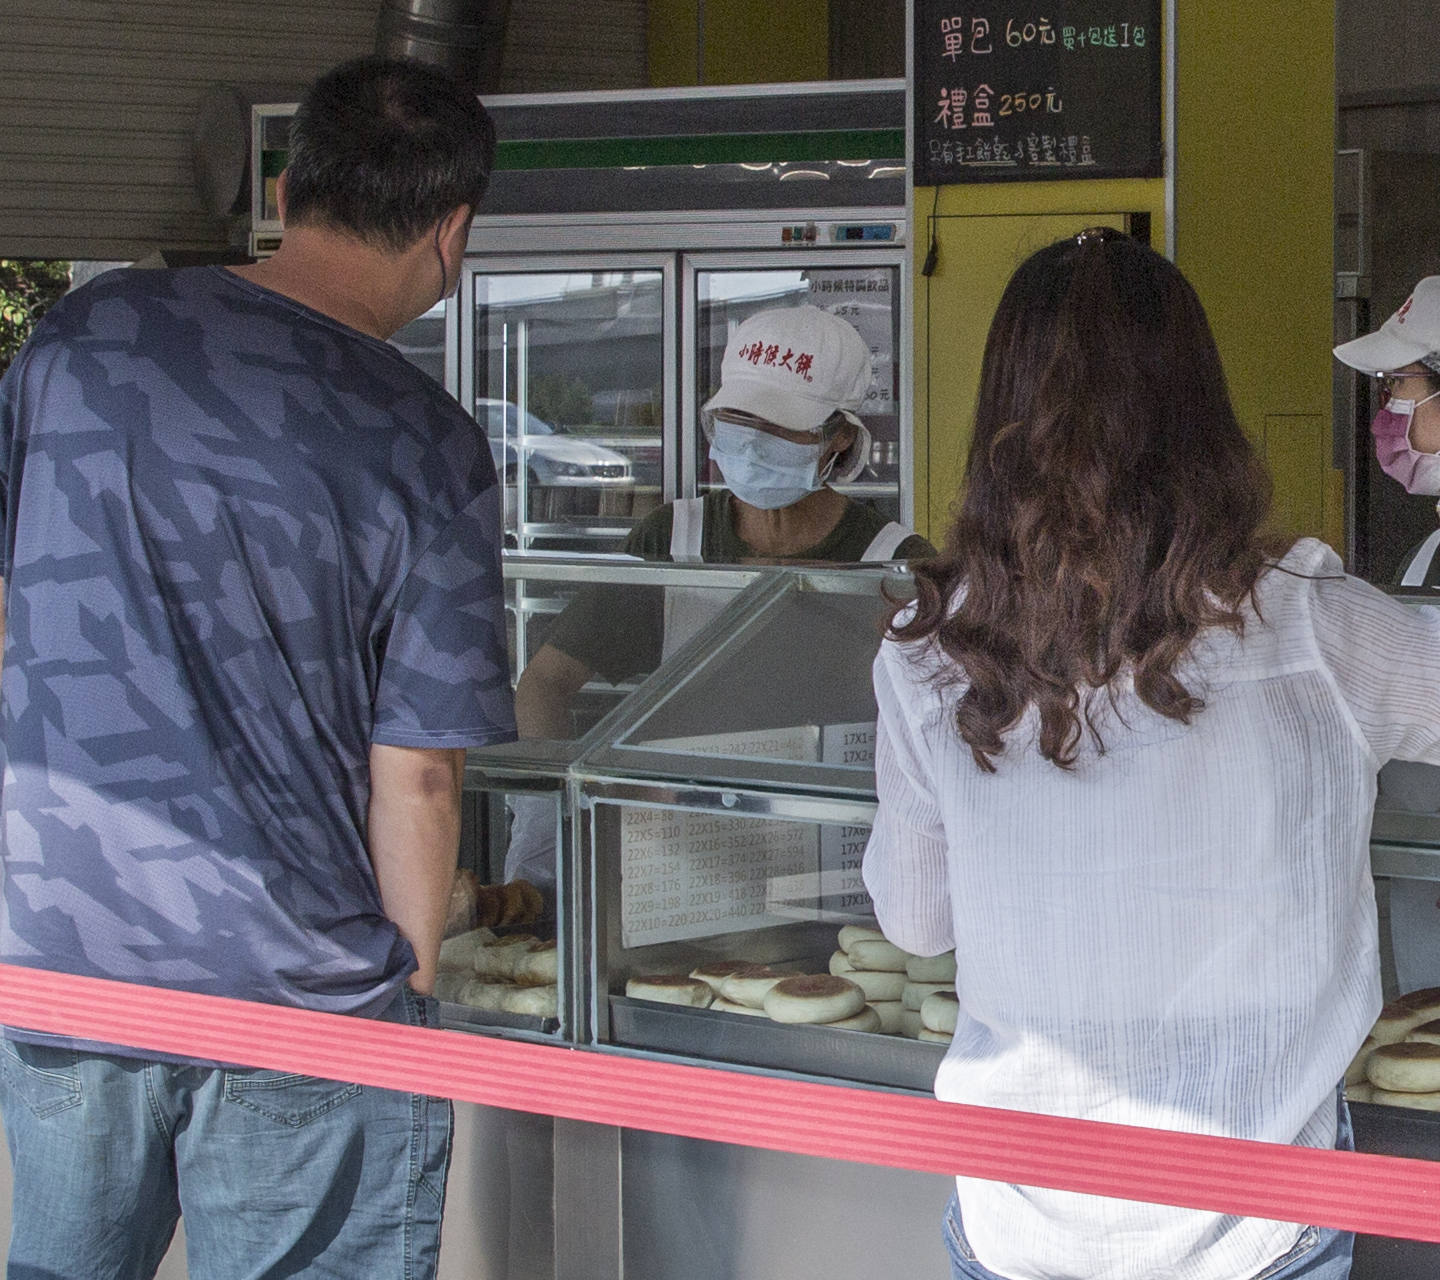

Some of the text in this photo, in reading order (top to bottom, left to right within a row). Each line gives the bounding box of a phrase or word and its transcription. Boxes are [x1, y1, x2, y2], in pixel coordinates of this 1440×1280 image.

[942, 17, 992, 62] 單包
[1006, 18, 1056, 47] 60元
[935, 84, 1062, 129] 禮盒 250元
